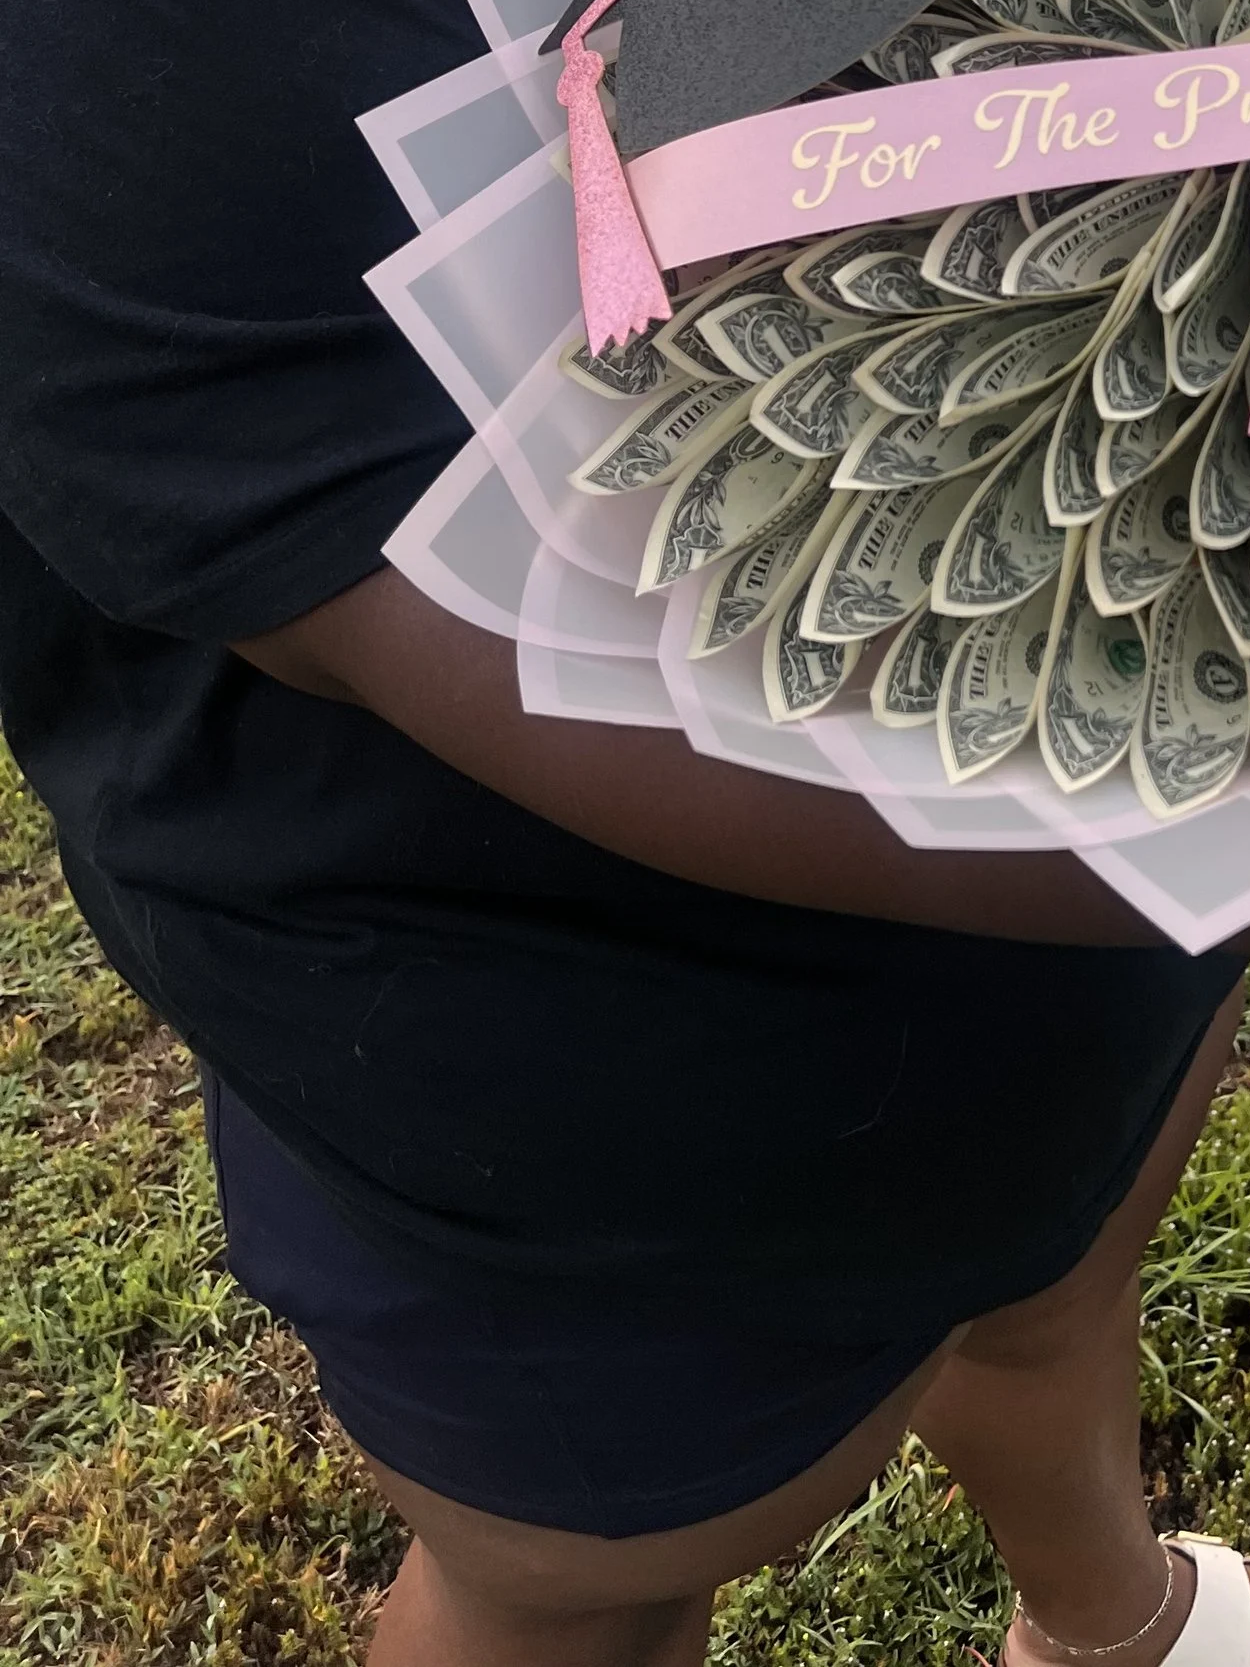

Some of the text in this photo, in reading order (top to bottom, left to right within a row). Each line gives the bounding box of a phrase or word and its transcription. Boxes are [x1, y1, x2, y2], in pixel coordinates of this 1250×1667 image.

[791, 114, 926, 211] For
[972, 86, 1118, 175] The
[1048, 229, 1089, 269] THE
[1093, 188, 1178, 232] UNITED
[763, 323, 797, 366] 1
[799, 368, 837, 414] 1
[664, 395, 712, 441] THE
[858, 518, 896, 571] THE
[1011, 514, 1024, 534] 12
[748, 539, 782, 590] THE
[968, 533, 987, 583] 1
[801, 650, 826, 686] 1
[907, 637, 928, 687] 1
[968, 642, 995, 701] THE
[1086, 680, 1104, 697] 12
[1063, 716, 1095, 755] 1
